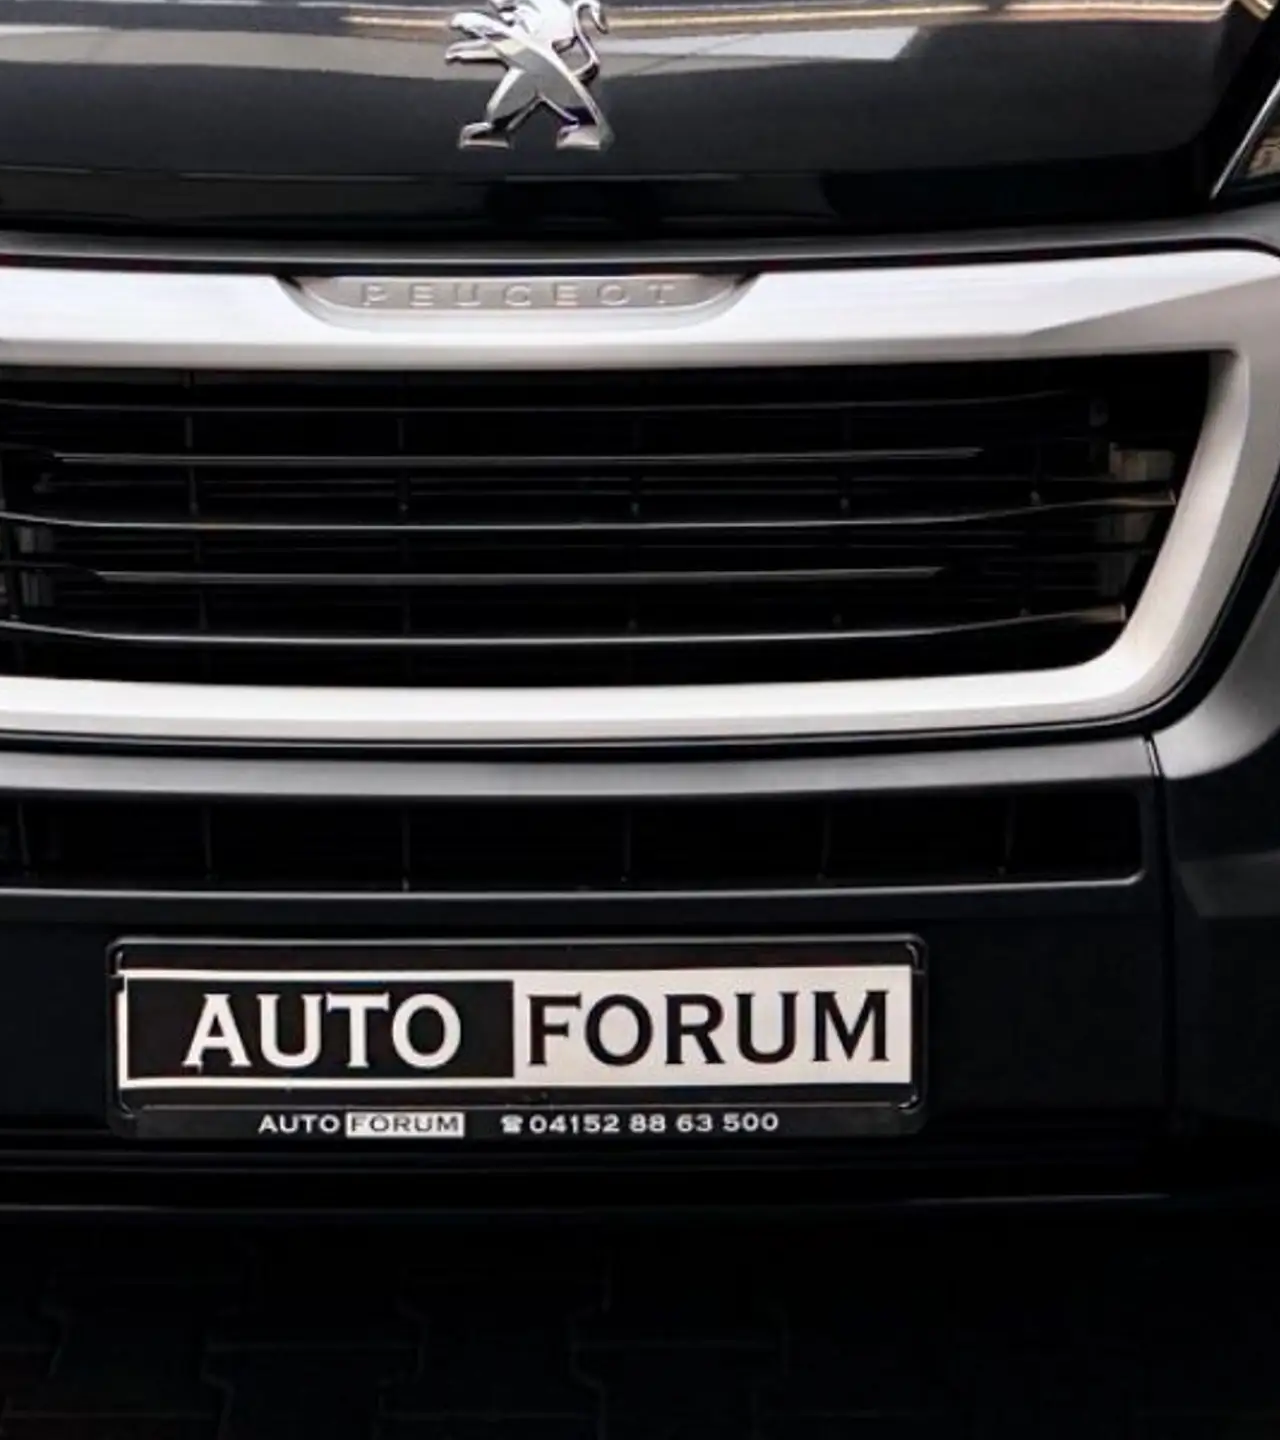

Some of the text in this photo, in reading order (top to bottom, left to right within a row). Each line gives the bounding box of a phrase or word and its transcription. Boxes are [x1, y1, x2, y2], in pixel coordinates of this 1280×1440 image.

[360, 282, 677, 307] PEUGEOT
[182, 990, 889, 1069] AUTO FORUM
[258, 1111, 779, 1134] AUTO FORUM 04152 88 63 500
